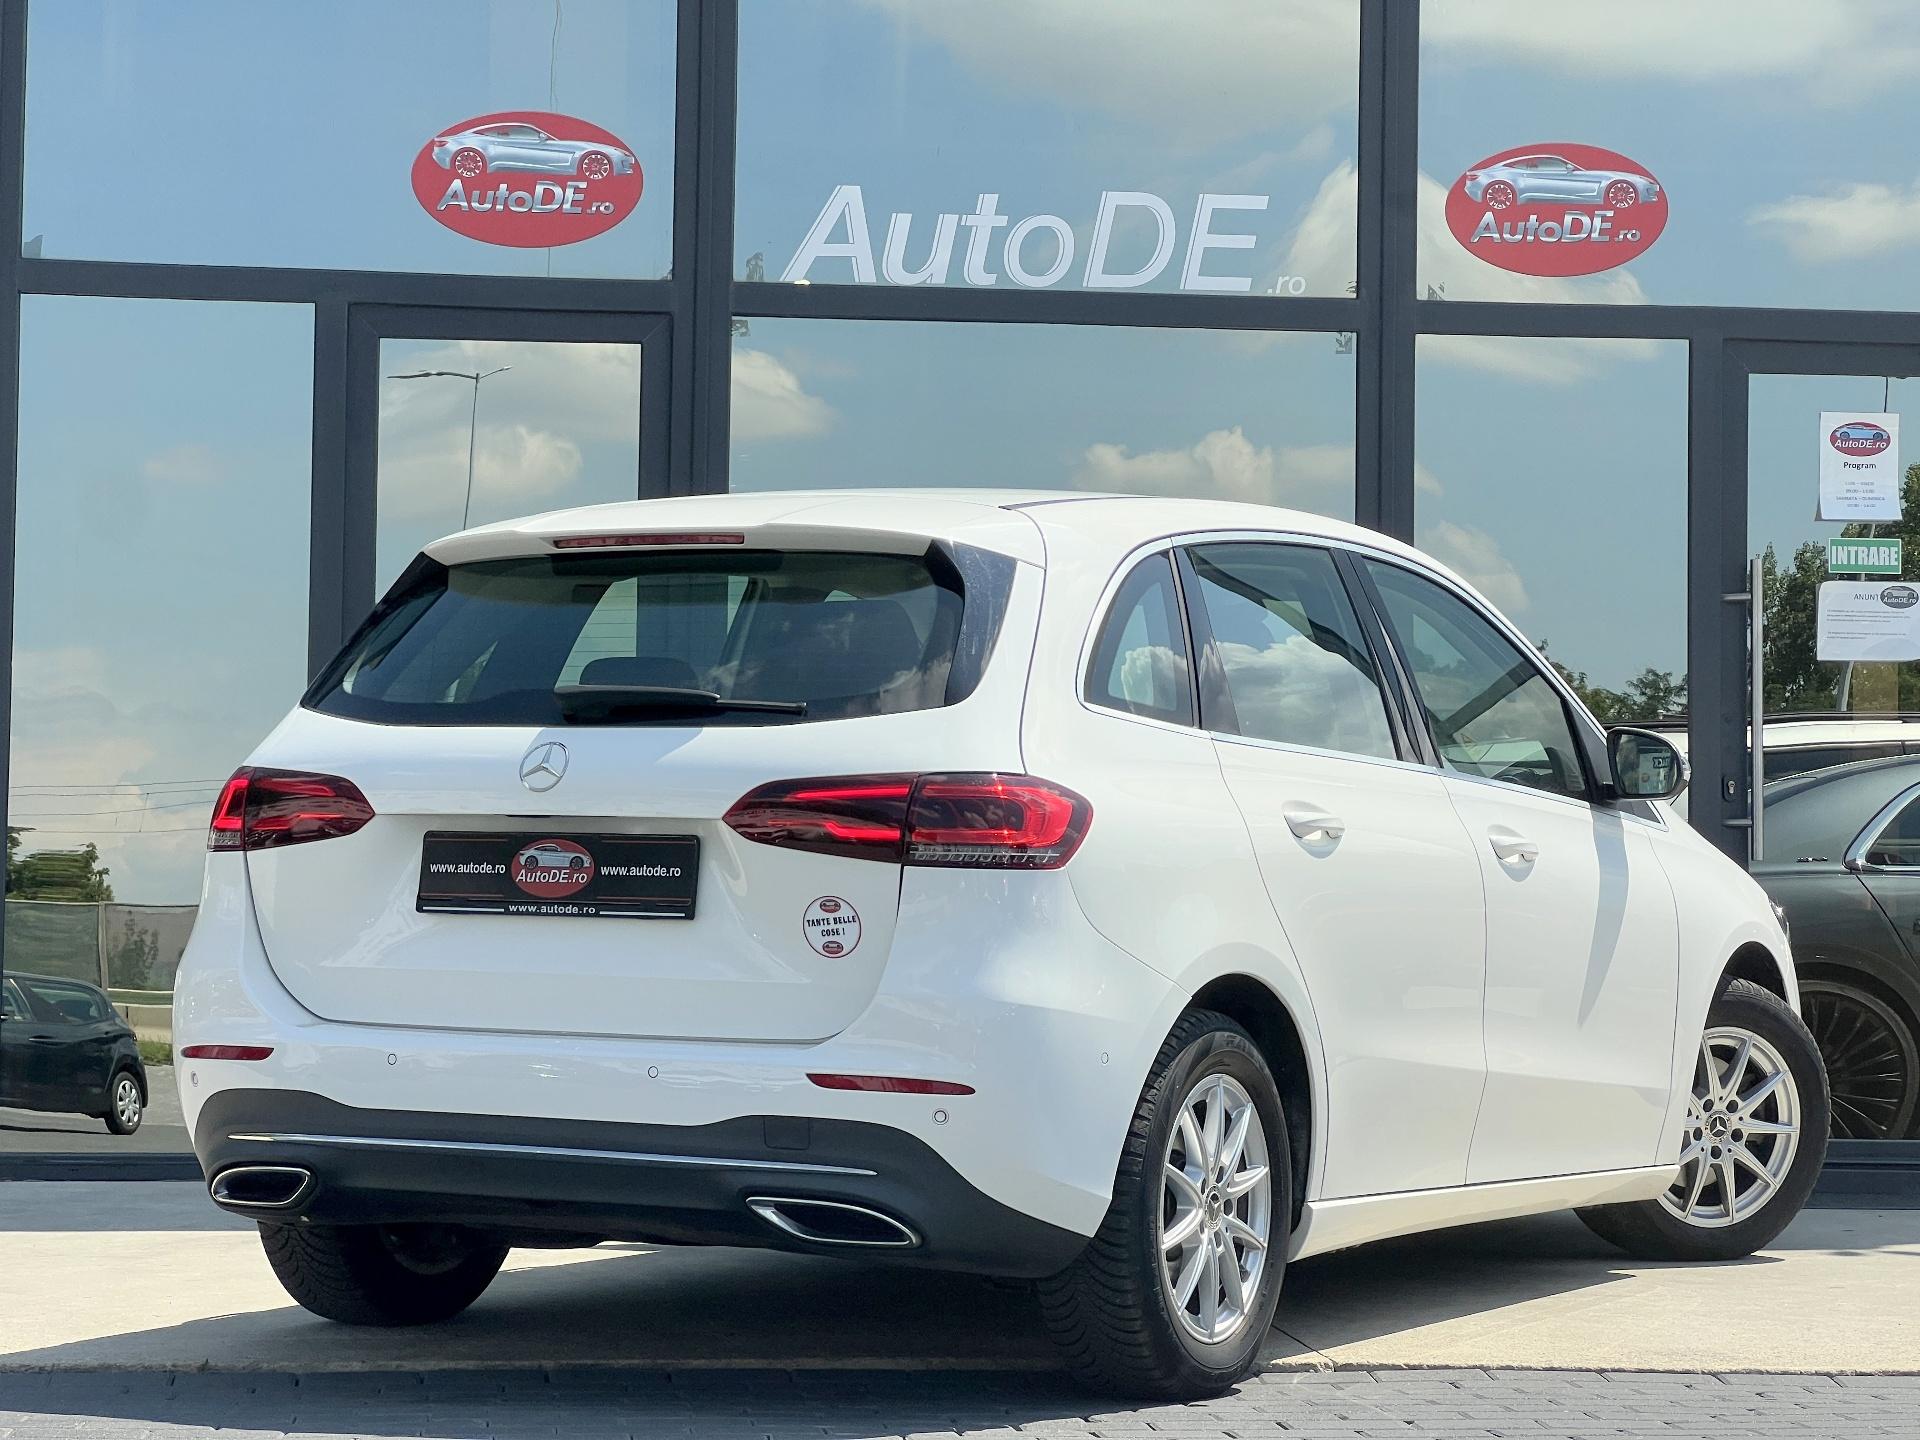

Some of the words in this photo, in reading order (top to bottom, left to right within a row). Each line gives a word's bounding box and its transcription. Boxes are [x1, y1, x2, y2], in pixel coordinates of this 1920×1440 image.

[1834, 439, 1887, 449] AutoDE.ro
[1843, 461, 1877, 471] Program
[1831, 545, 1899, 566] INTRARE
[429, 861, 506, 875] www.autode.ro
[600, 865, 682, 878] www.autode.ro
[515, 868, 588, 884] AutoDE.ro
[508, 902, 596, 915] www.autode.ro
[806, 917, 831, 927] TANTE
[832, 915, 857, 925] BELLE
[821, 927, 841, 937] COSE
